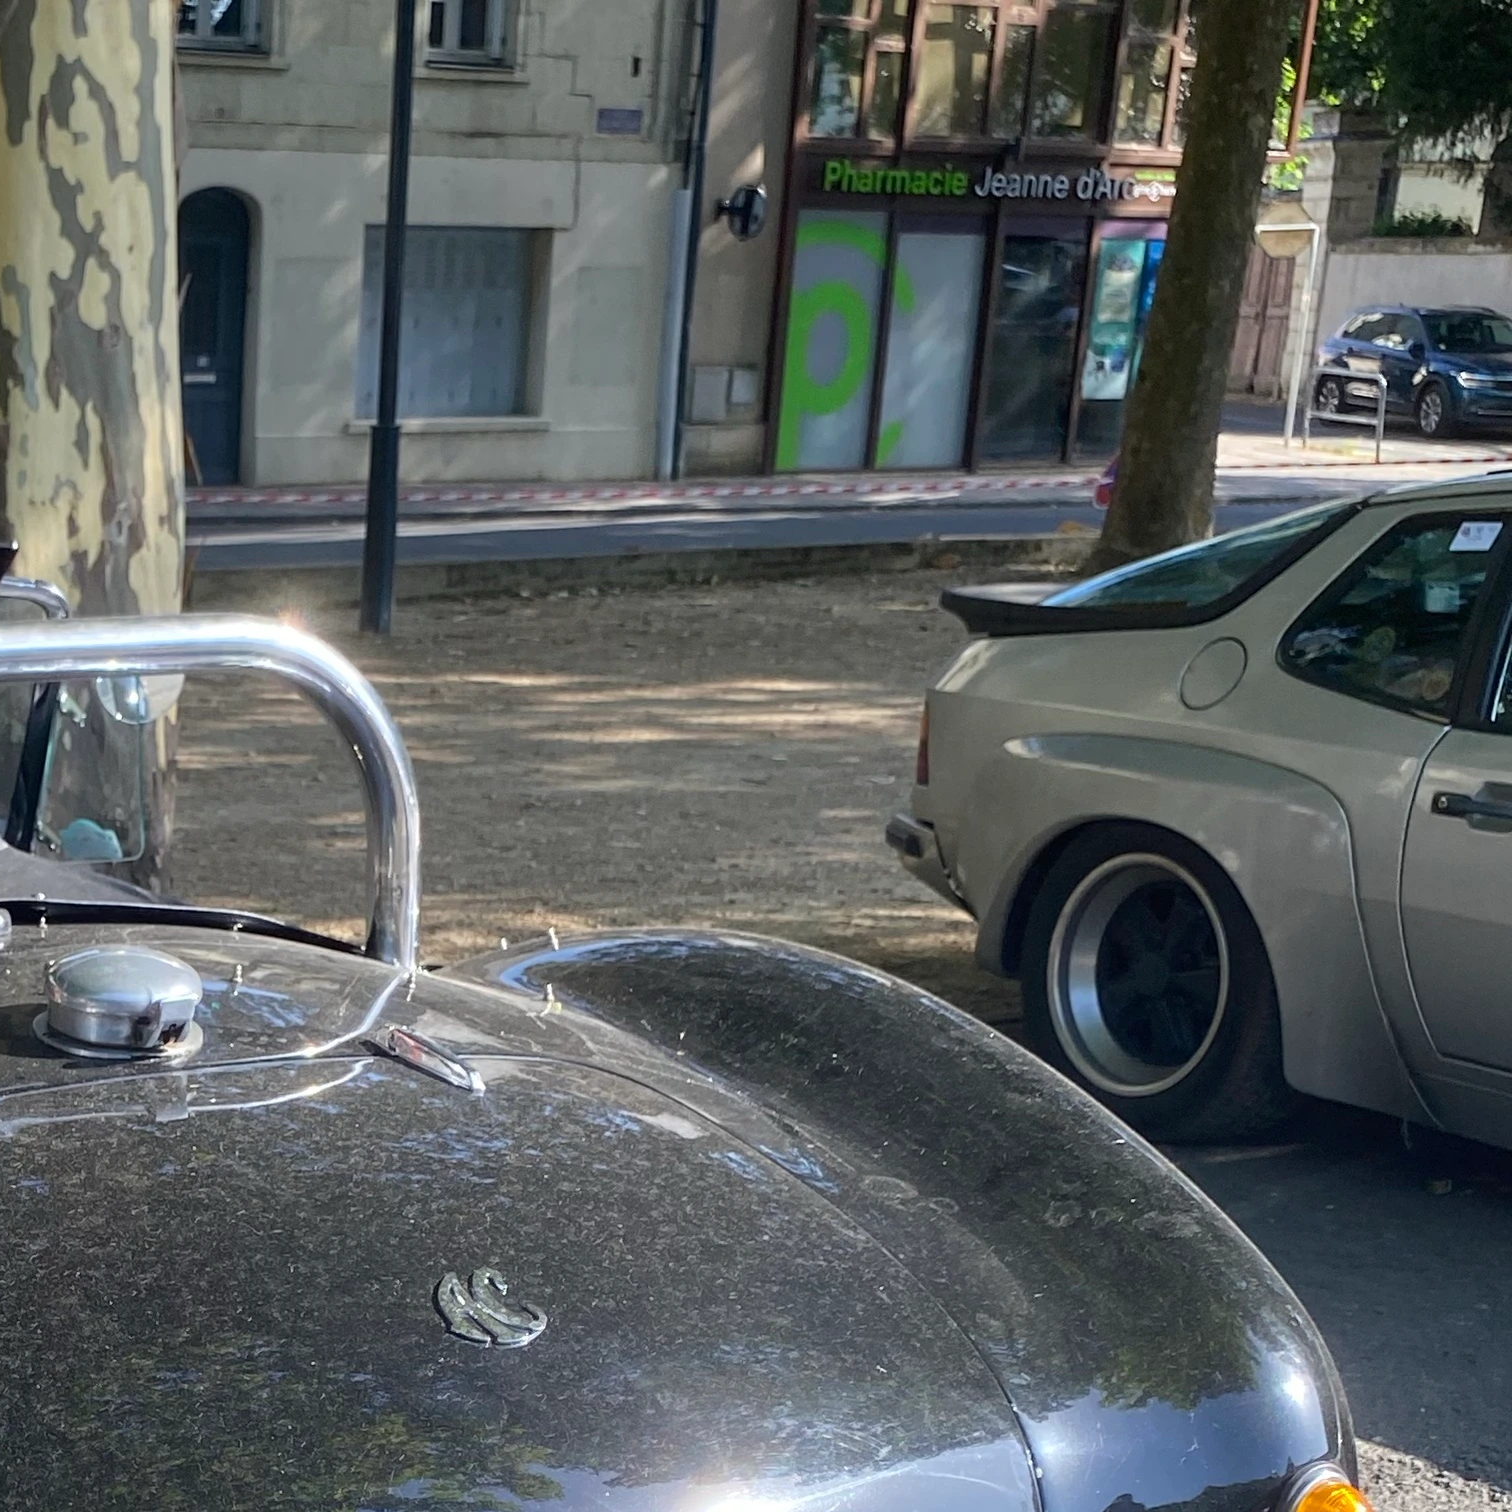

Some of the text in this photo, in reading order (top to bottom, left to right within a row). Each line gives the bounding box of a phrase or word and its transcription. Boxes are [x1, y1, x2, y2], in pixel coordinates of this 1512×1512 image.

[823, 158, 969, 197] Pharmacie
[974, 165, 1070, 200] Jeanne
[1076, 167, 1137, 201] d'Arc
